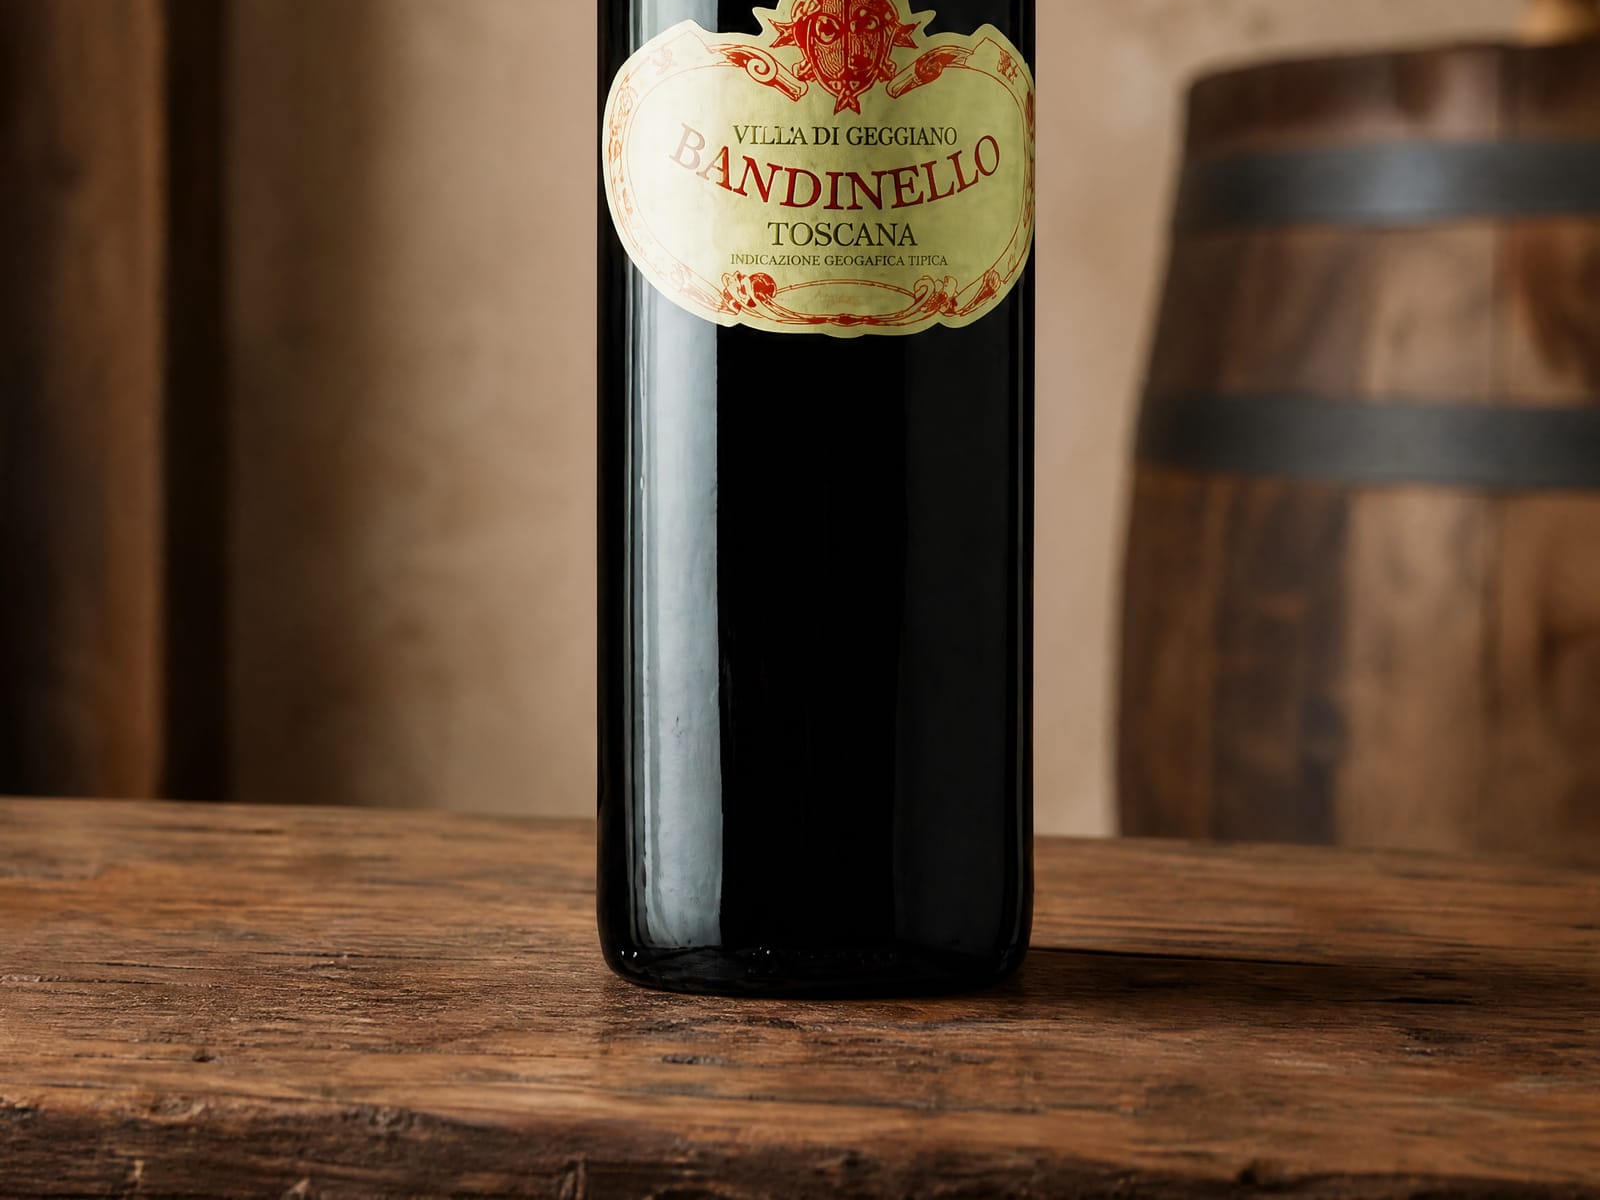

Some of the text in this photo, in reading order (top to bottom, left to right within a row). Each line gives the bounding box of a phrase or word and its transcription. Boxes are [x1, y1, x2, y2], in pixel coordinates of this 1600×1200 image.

[811, 126, 840, 146] DI
[846, 126, 958, 146] GEGGIANO
[669, 123, 1000, 211] BANDINELLO
[767, 221, 918, 247] TOSCANA
[730, 254, 820, 267] INDICAZIONE
[908, 255, 949, 267] TIPICA
